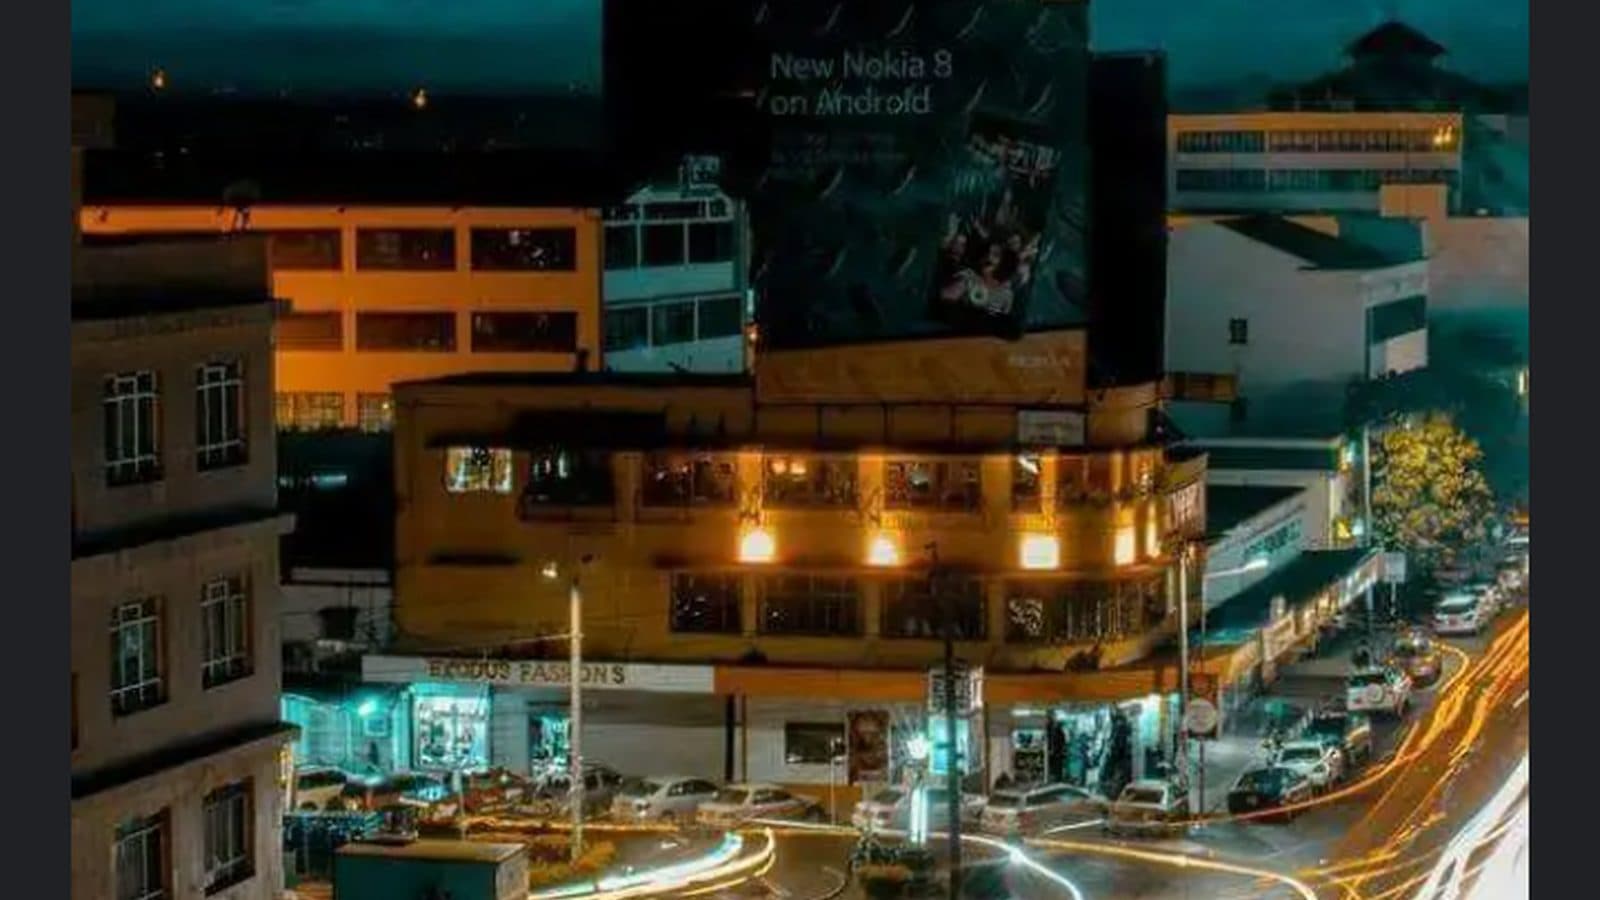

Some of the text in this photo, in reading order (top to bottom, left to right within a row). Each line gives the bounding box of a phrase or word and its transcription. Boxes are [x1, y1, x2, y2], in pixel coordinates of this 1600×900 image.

[770, 48, 953, 79] New Nokia 8
[769, 85, 932, 115] on Android
[519, 663, 626, 684] FASHONS
